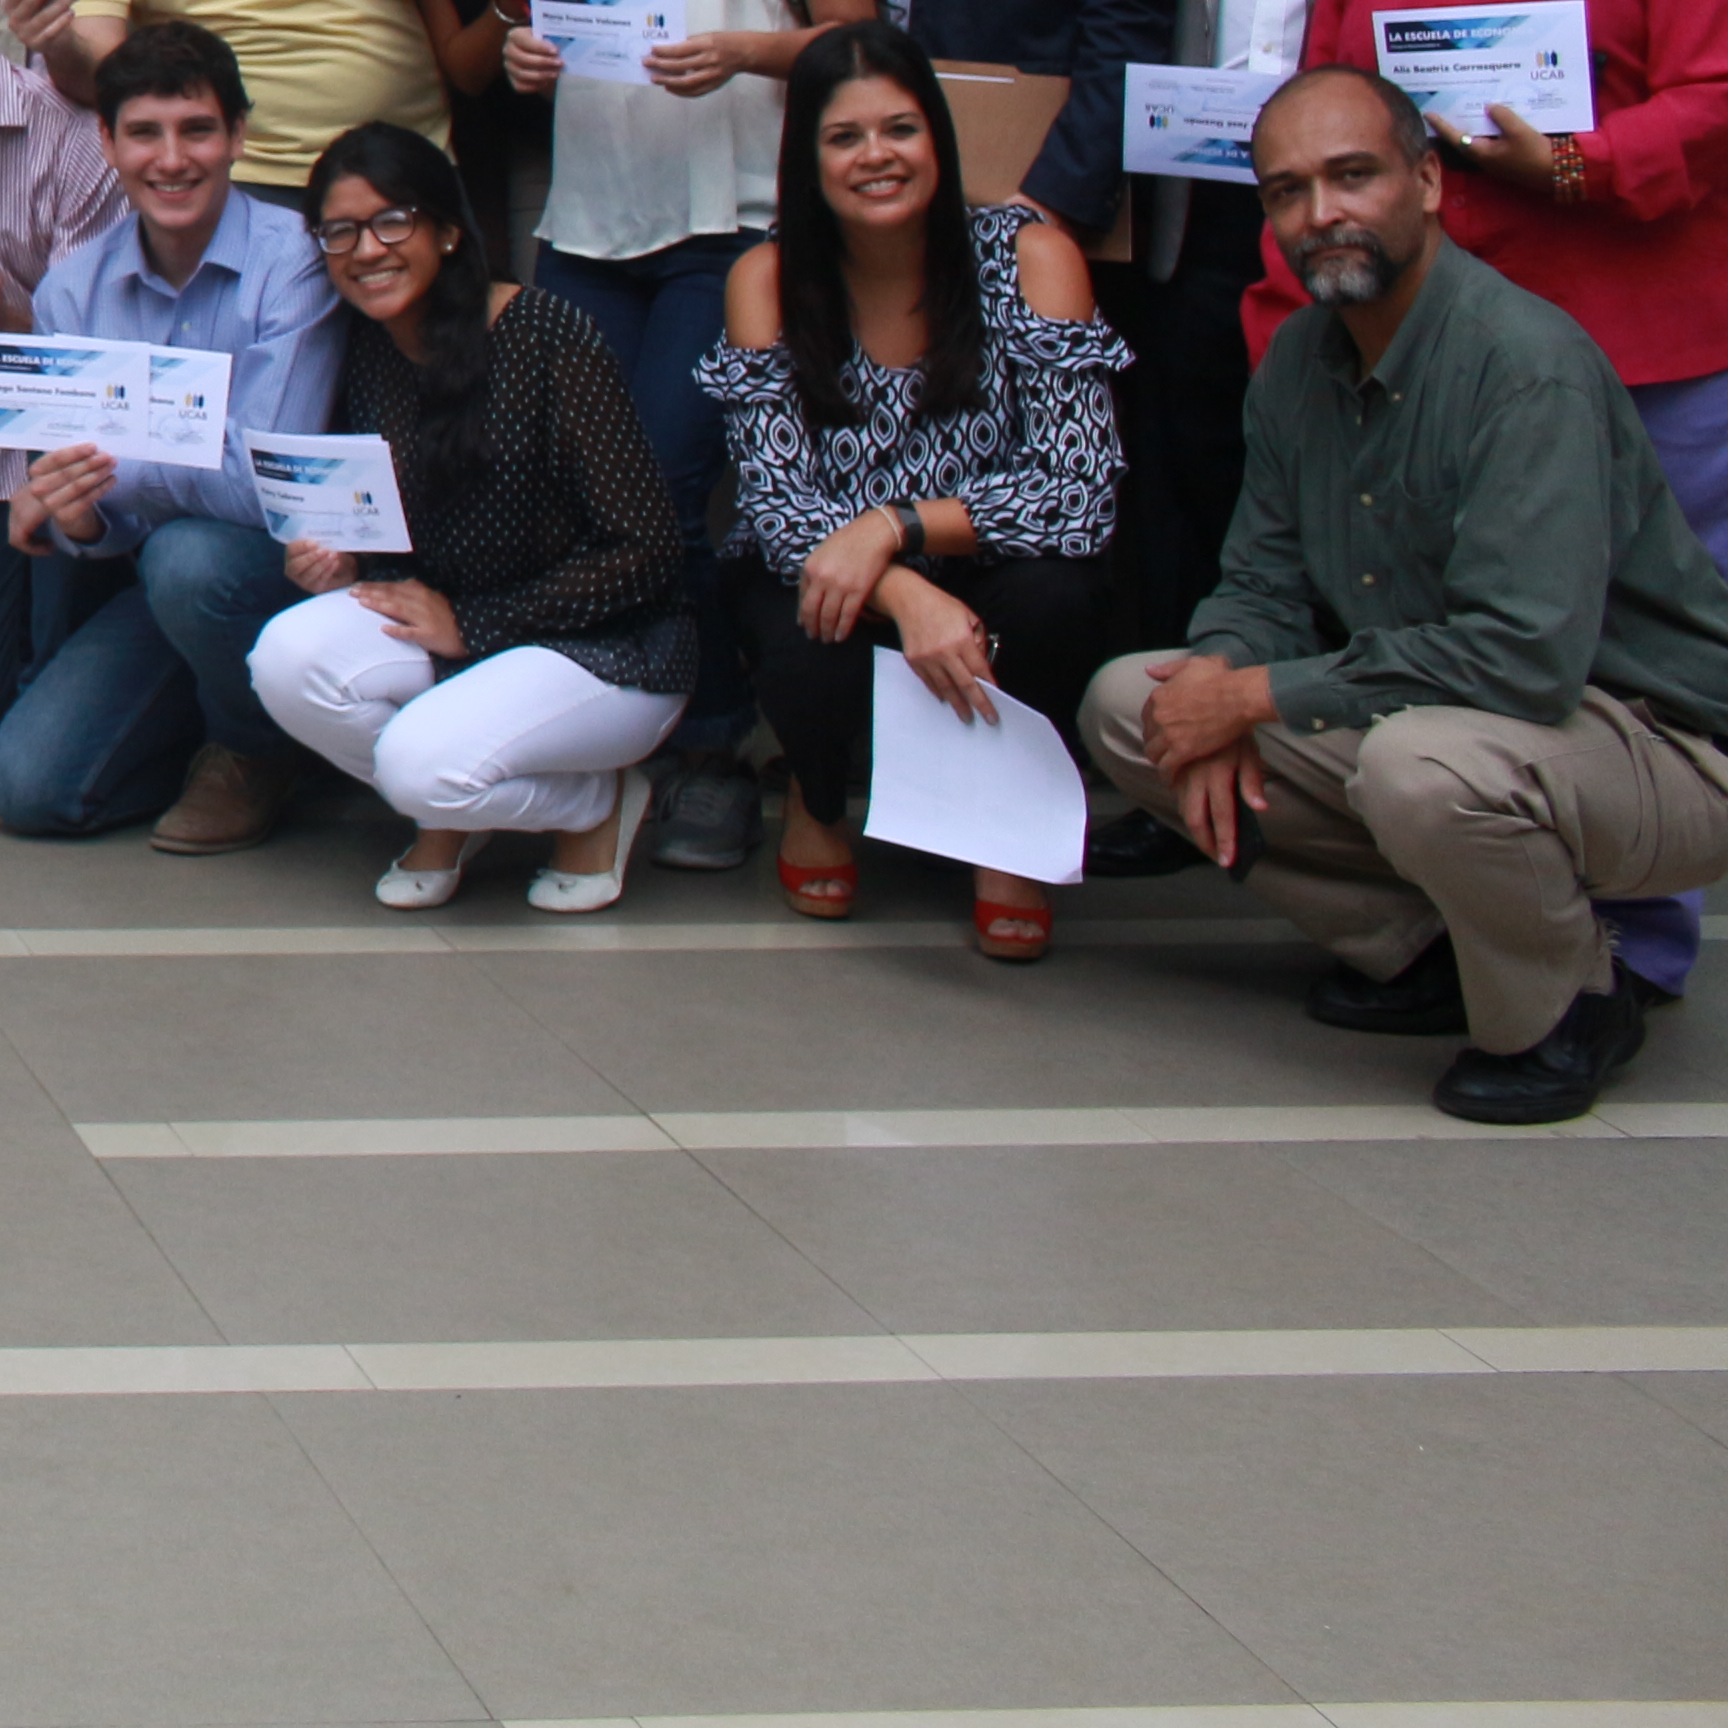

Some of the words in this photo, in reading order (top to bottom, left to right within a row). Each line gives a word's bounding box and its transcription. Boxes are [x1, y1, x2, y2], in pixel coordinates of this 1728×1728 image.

[643, 30, 670, 39] UCAB
[1389, 32, 1402, 42] LA
[1405, 30, 1450, 40] ESCUELA
[1454, 28, 1467, 38] DE
[1413, 64, 1450, 73] Beatriz
[1530, 71, 1565, 80] UCAB
[2, 354, 41, 365] ESCUELA
[101, 400, 130, 411] UCAB
[178, 410, 208, 421] UCAB
